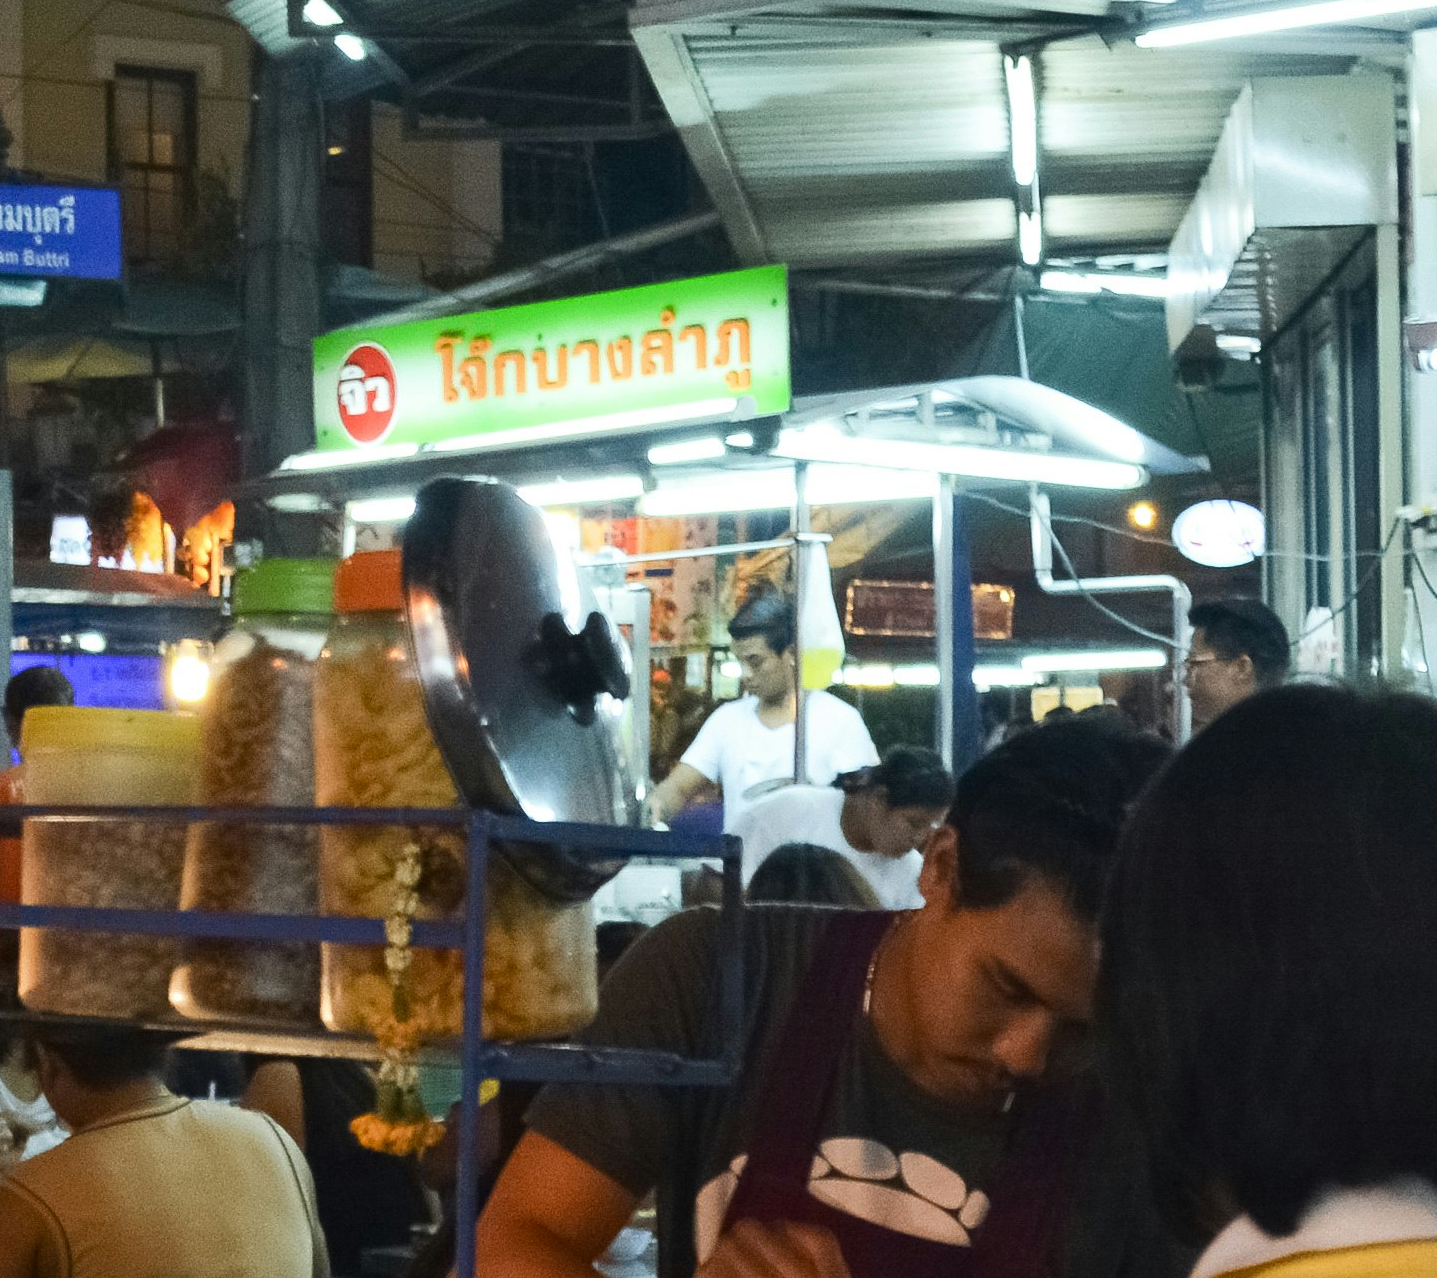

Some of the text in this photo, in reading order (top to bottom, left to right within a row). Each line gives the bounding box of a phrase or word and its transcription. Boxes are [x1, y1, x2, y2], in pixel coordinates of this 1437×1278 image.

[23, 249, 71, 269] Buttri
[434, 304, 752, 404] โจ๊กบางลำภู
